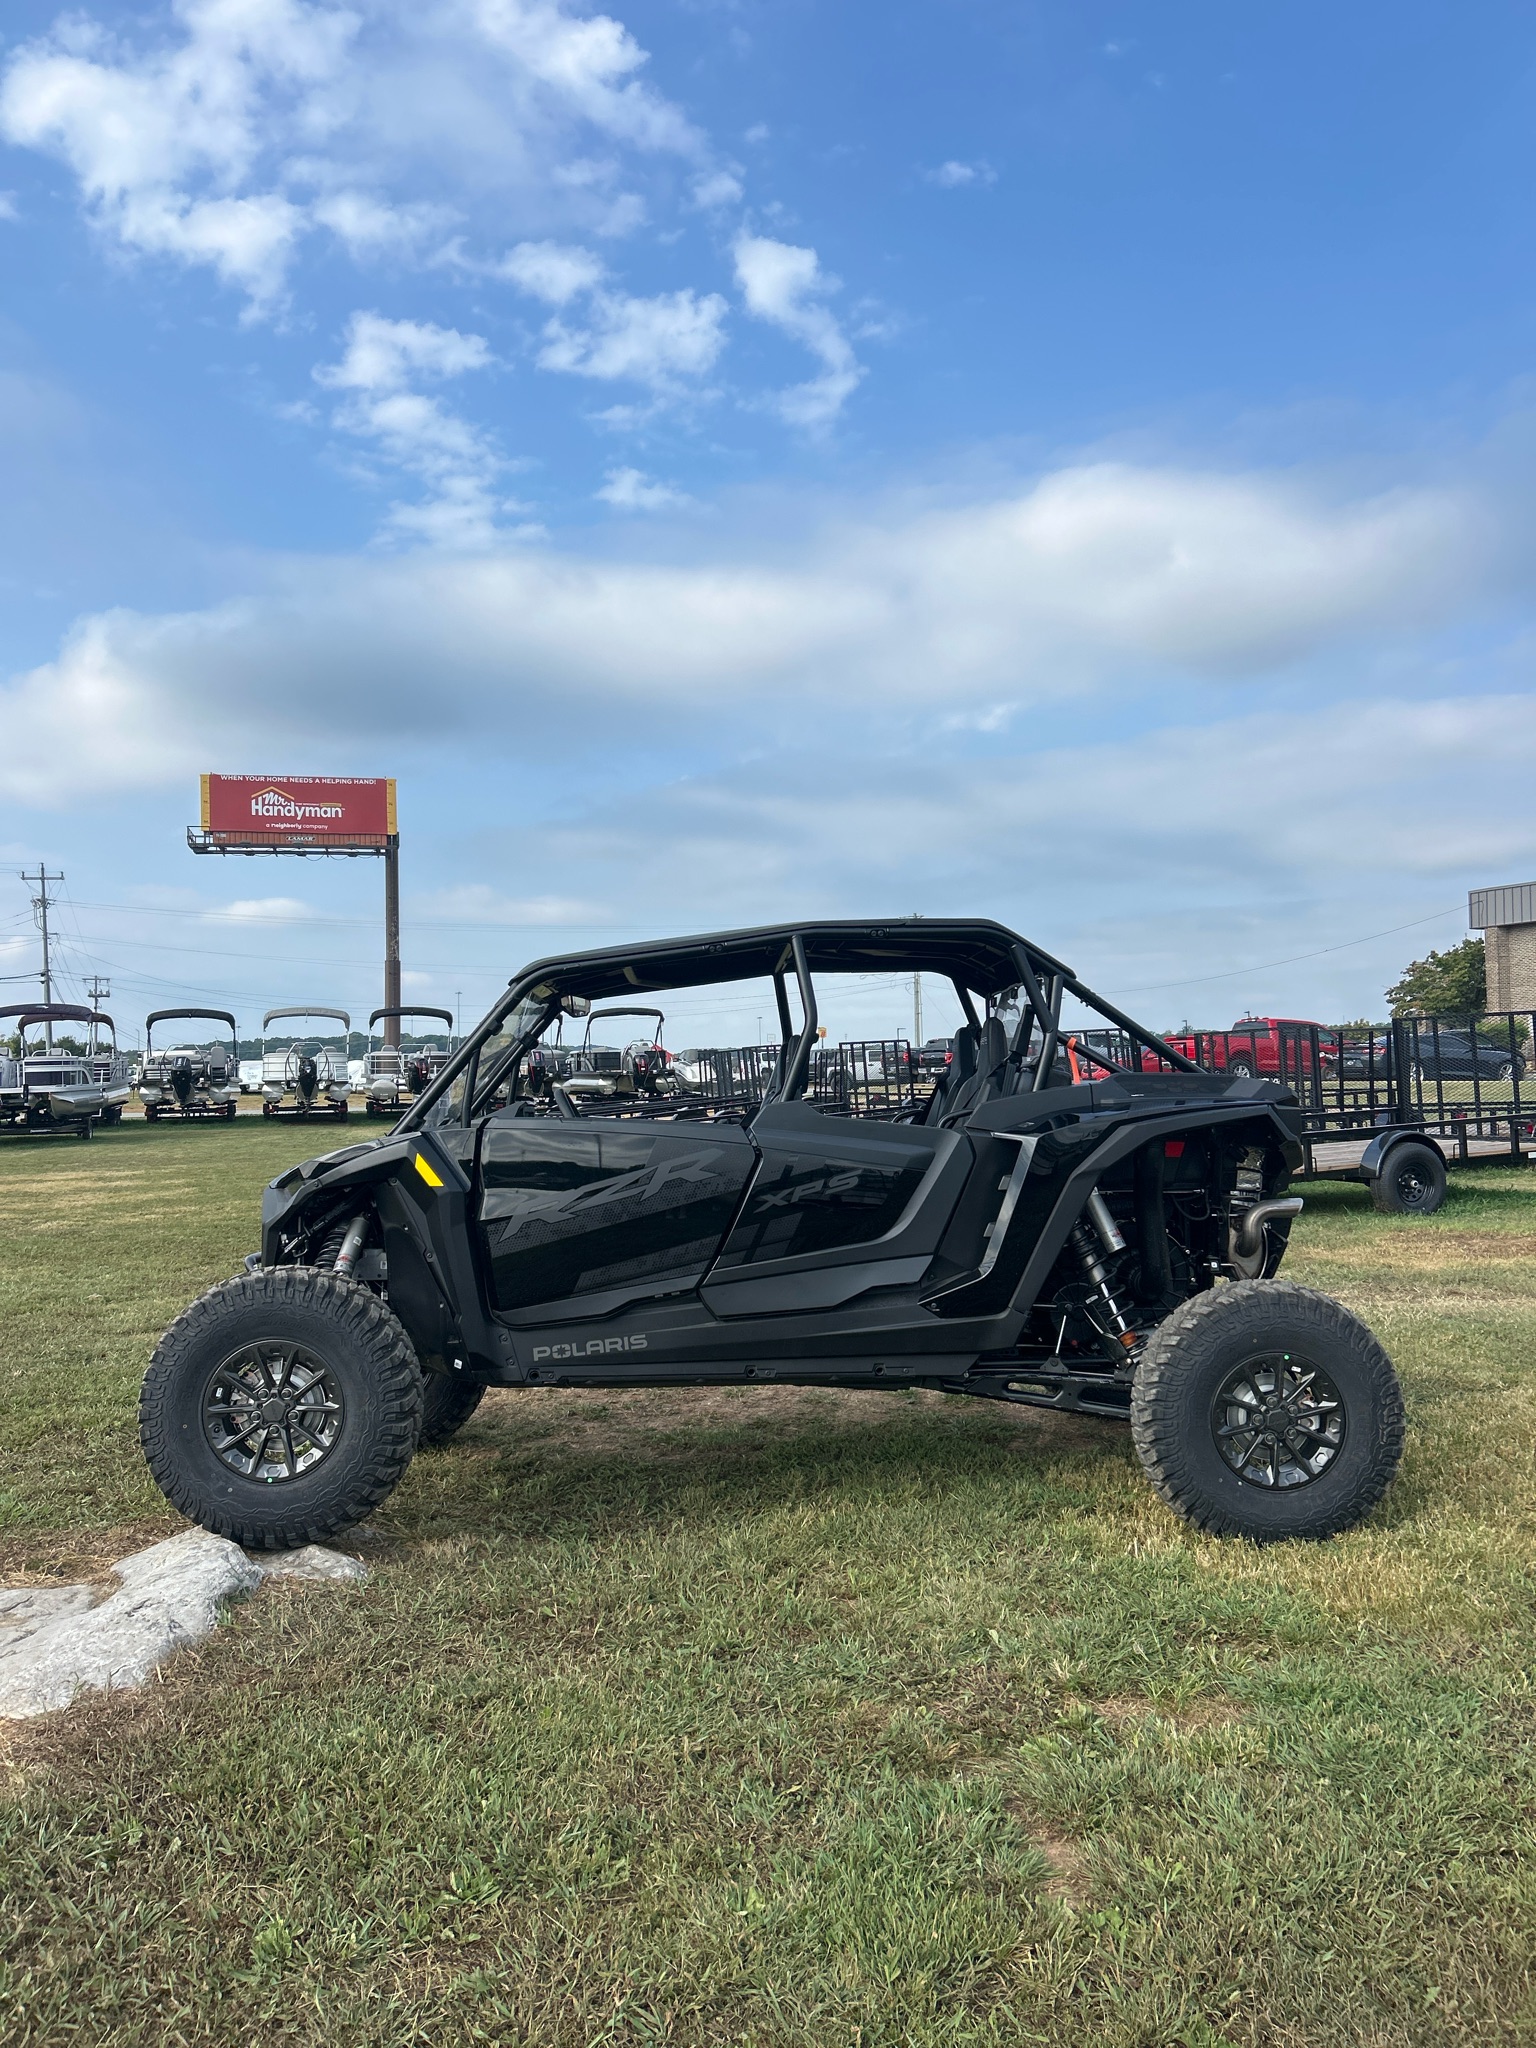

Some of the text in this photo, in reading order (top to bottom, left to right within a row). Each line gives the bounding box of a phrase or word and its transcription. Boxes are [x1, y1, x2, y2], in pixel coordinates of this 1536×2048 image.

[251, 796, 342, 820] Handyman
[263, 792, 291, 805] Mr.
[271, 822, 302, 830] neighborly
[497, 1147, 727, 1243] RZR
[532, 1333, 649, 1362] POLARIS
